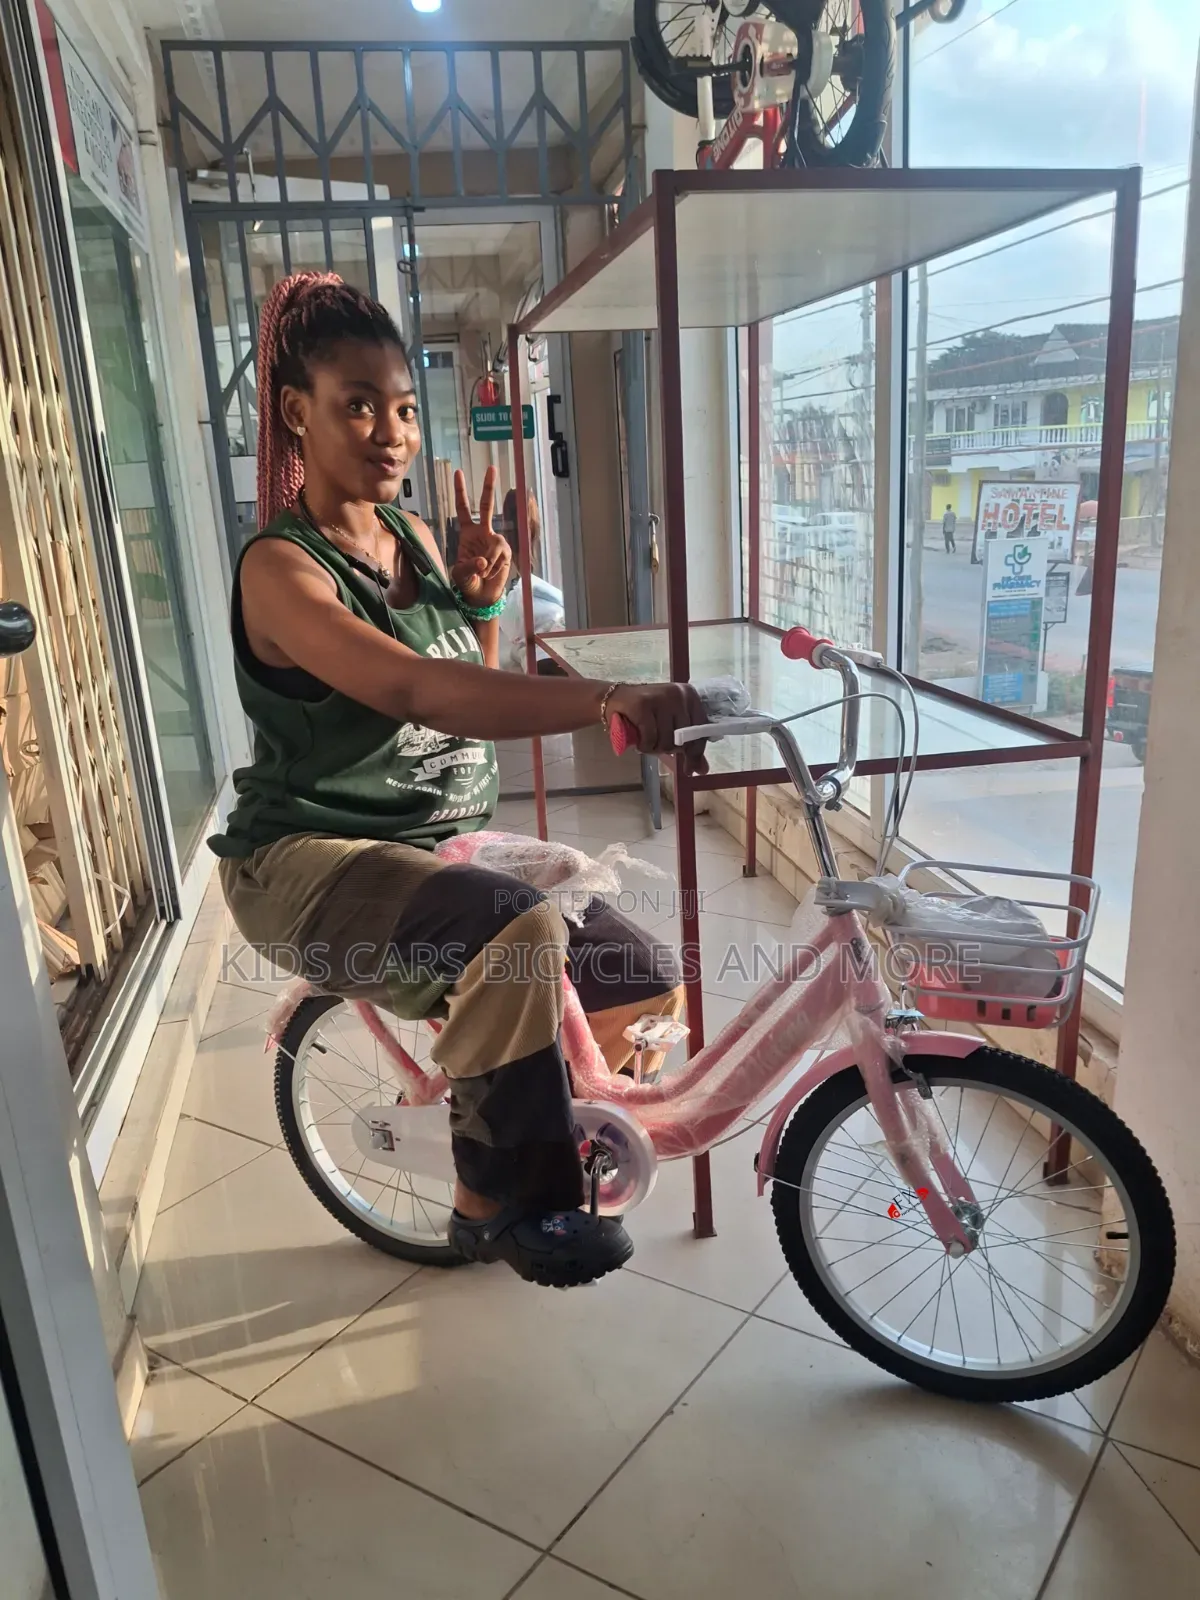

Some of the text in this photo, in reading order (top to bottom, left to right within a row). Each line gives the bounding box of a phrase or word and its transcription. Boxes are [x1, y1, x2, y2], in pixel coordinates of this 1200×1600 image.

[475, 412, 496, 422] SLIDE
[498, 411, 508, 421] TO
[980, 502, 1071, 533] HOTEL
[385, 777, 413, 790] NEVER
[415, 785, 443, 796] AGAIN
